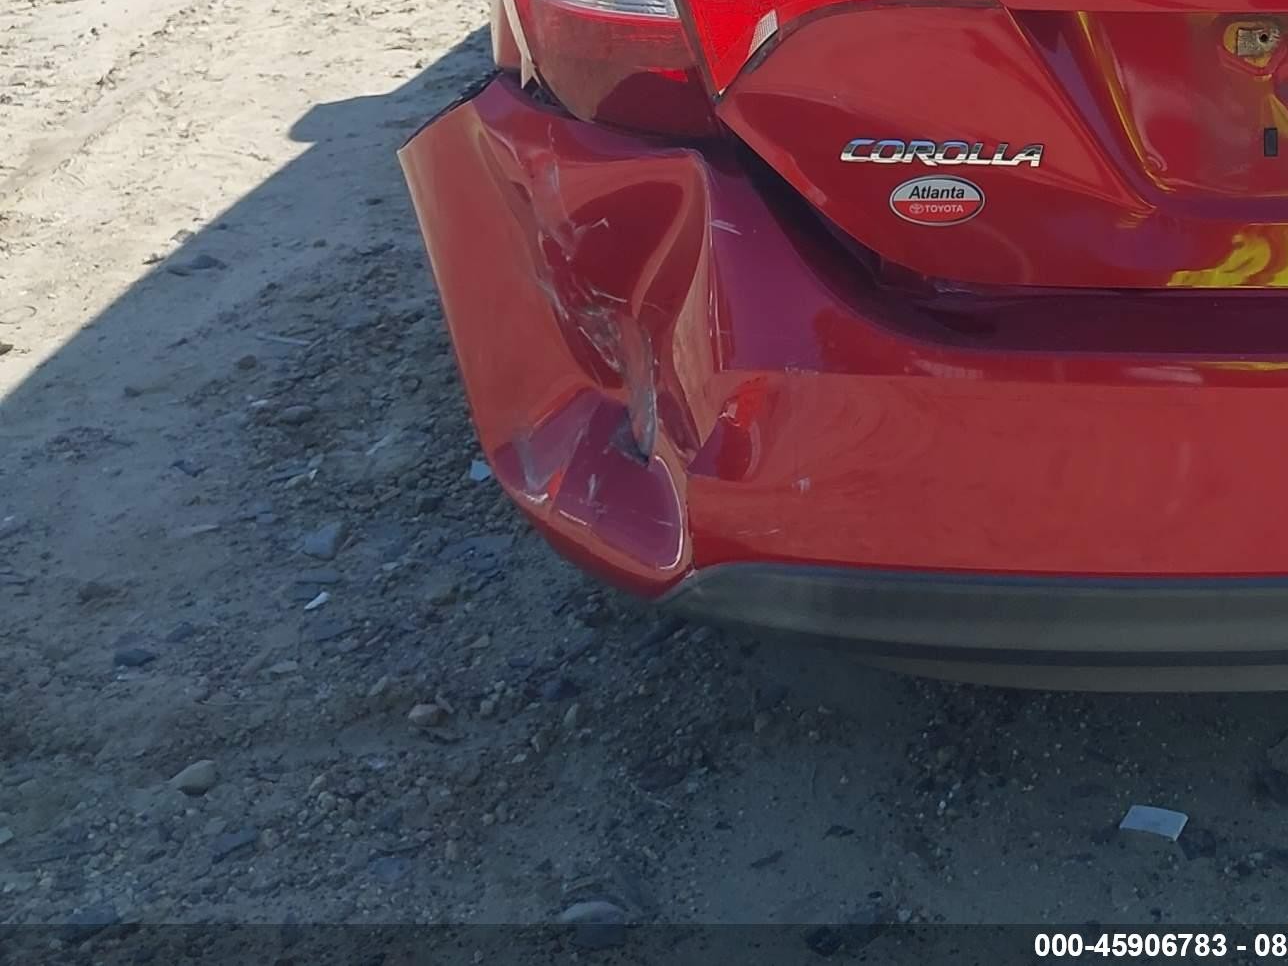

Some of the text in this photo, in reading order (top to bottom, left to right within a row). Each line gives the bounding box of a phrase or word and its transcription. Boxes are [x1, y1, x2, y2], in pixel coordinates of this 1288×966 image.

[840, 137, 1044, 168] COROLLA
[908, 185, 965, 200] Atlanta
[924, 204, 965, 214] TOYOTA
